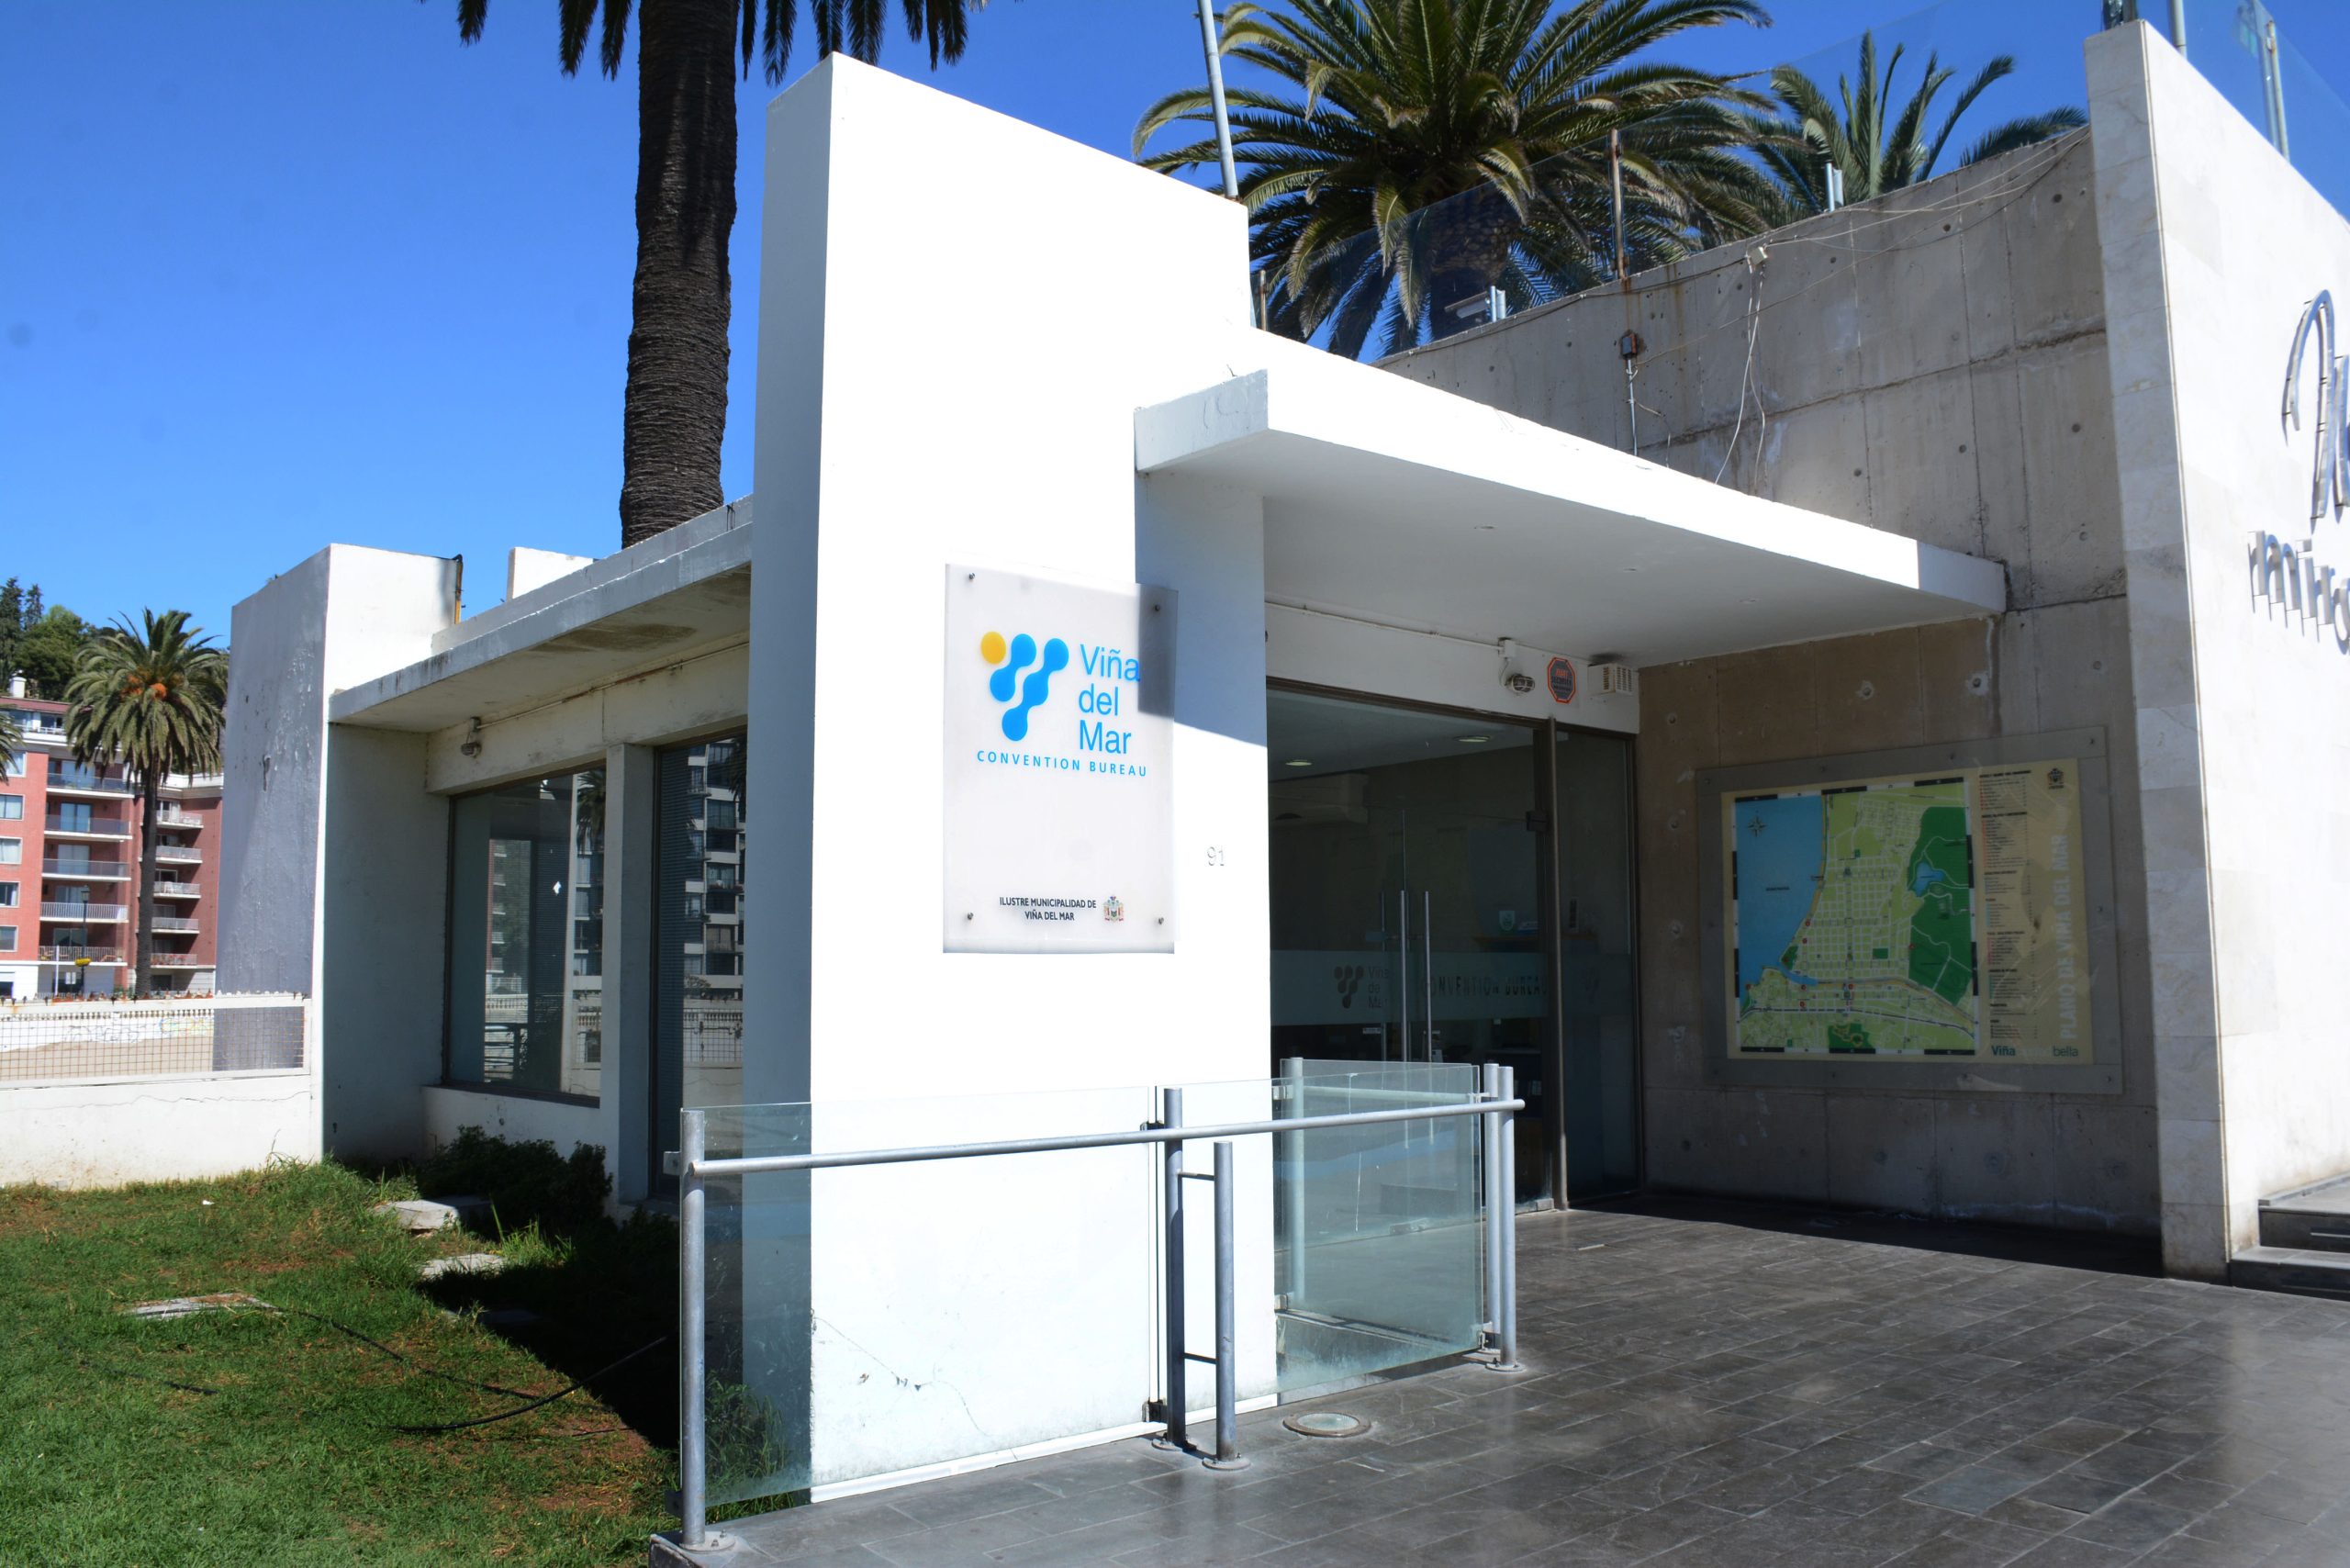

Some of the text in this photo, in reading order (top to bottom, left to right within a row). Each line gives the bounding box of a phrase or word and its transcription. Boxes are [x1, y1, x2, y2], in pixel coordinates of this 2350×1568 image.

[1080, 644, 1141, 682] Viña
[1079, 683, 1118, 716] del
[1080, 719, 1132, 754] Mar
[977, 750, 1147, 777] CONVENTION BUREAU
[2051, 834, 2070, 871] MAR
[1000, 897, 1097, 909] ILUSTRE MUNICIPALIDAD DE
[2053, 876, 2071, 906] DEL
[1024, 909, 1075, 921] VIÑA DEL MAR
[2056, 958, 2075, 979] DE
[2057, 984, 2077, 1039] PLANO
[1991, 1045, 2016, 1057] Viña
[2053, 1045, 2078, 1057] bella
